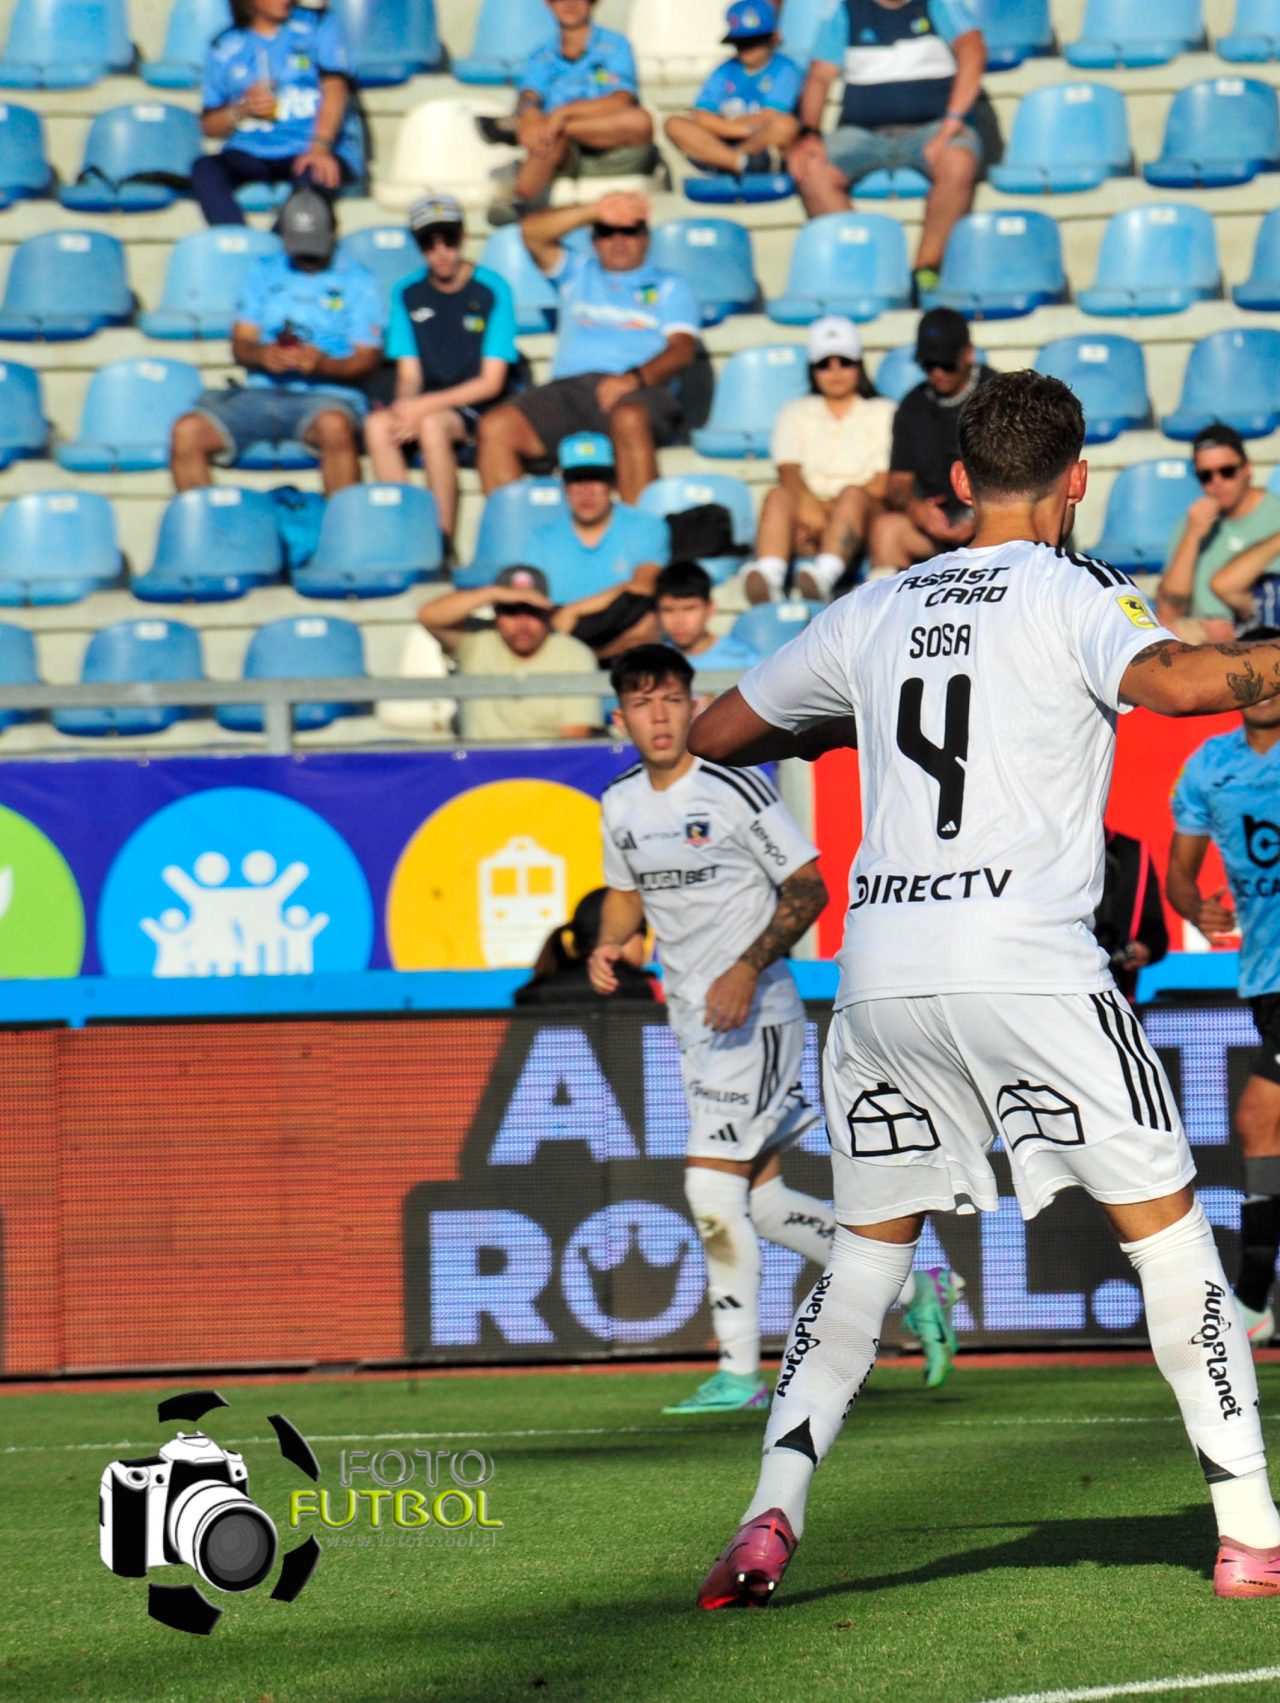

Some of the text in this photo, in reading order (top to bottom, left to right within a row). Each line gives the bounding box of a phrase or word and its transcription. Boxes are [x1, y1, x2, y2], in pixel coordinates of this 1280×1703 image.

[896, 565, 1010, 593] ASSIST
[924, 585, 1009, 608] CARD
[909, 622, 972, 660] SOSA
[896, 673, 972, 841] 4
[848, 867, 1014, 911] DIRECTV
[776, 1271, 834, 1398] AutoPlanet
[1188, 1280, 1243, 1421] AutoPlanet
